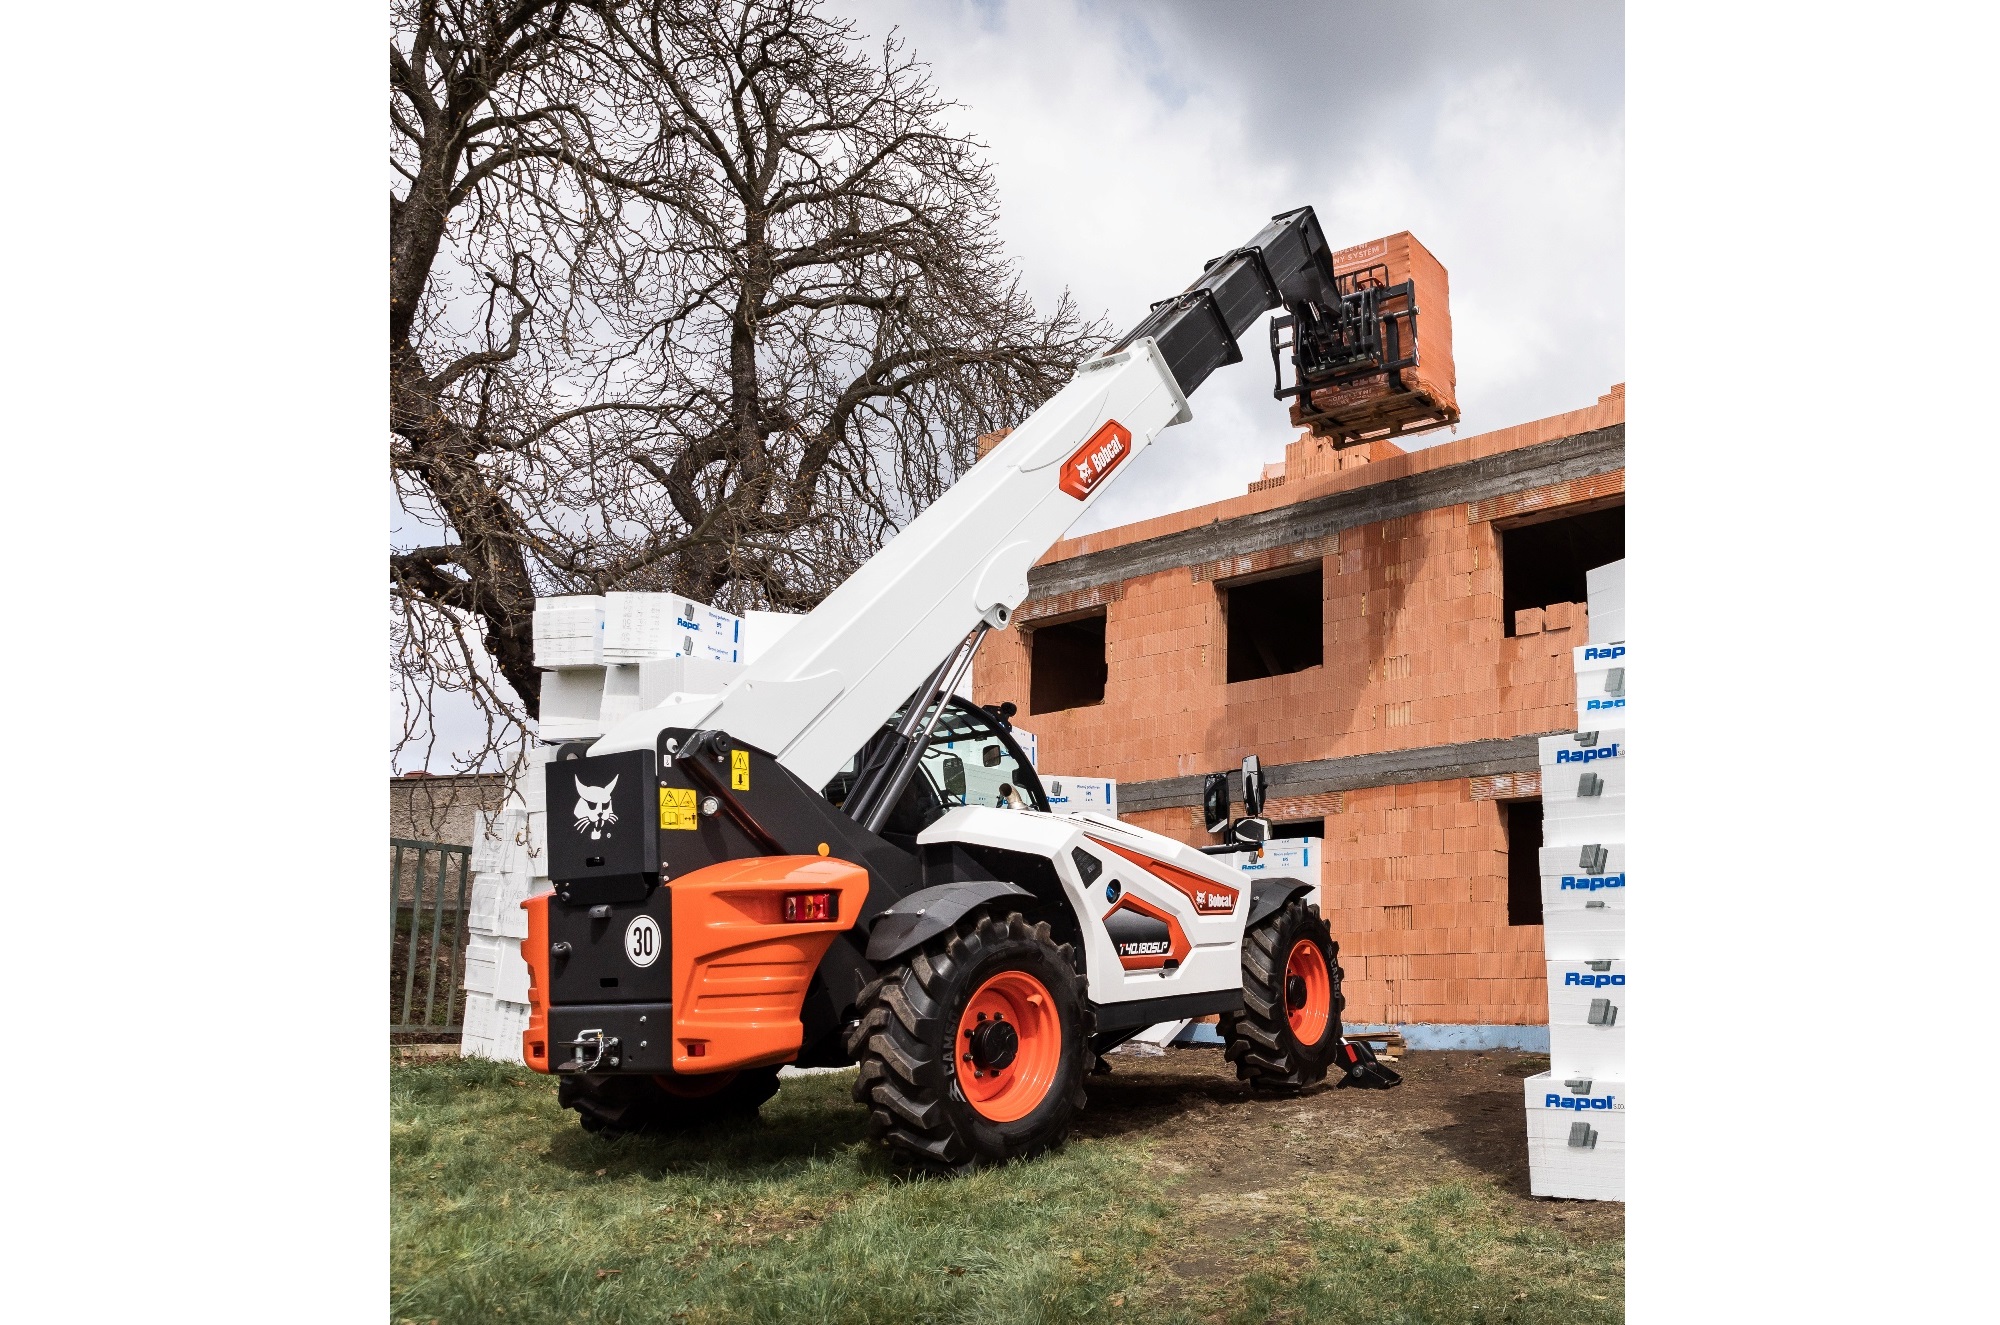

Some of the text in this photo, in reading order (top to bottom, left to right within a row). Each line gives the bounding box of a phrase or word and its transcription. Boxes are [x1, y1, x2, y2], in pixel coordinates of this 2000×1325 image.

[1347, 245, 1380, 261] SYSTÉM
[1091, 433, 1123, 473] Bobcat
[1557, 743, 1618, 764] Rapol
[1208, 893, 1232, 908] Bobcat
[633, 926, 653, 957] 30
[1545, 1093, 1614, 1112] Rapol
